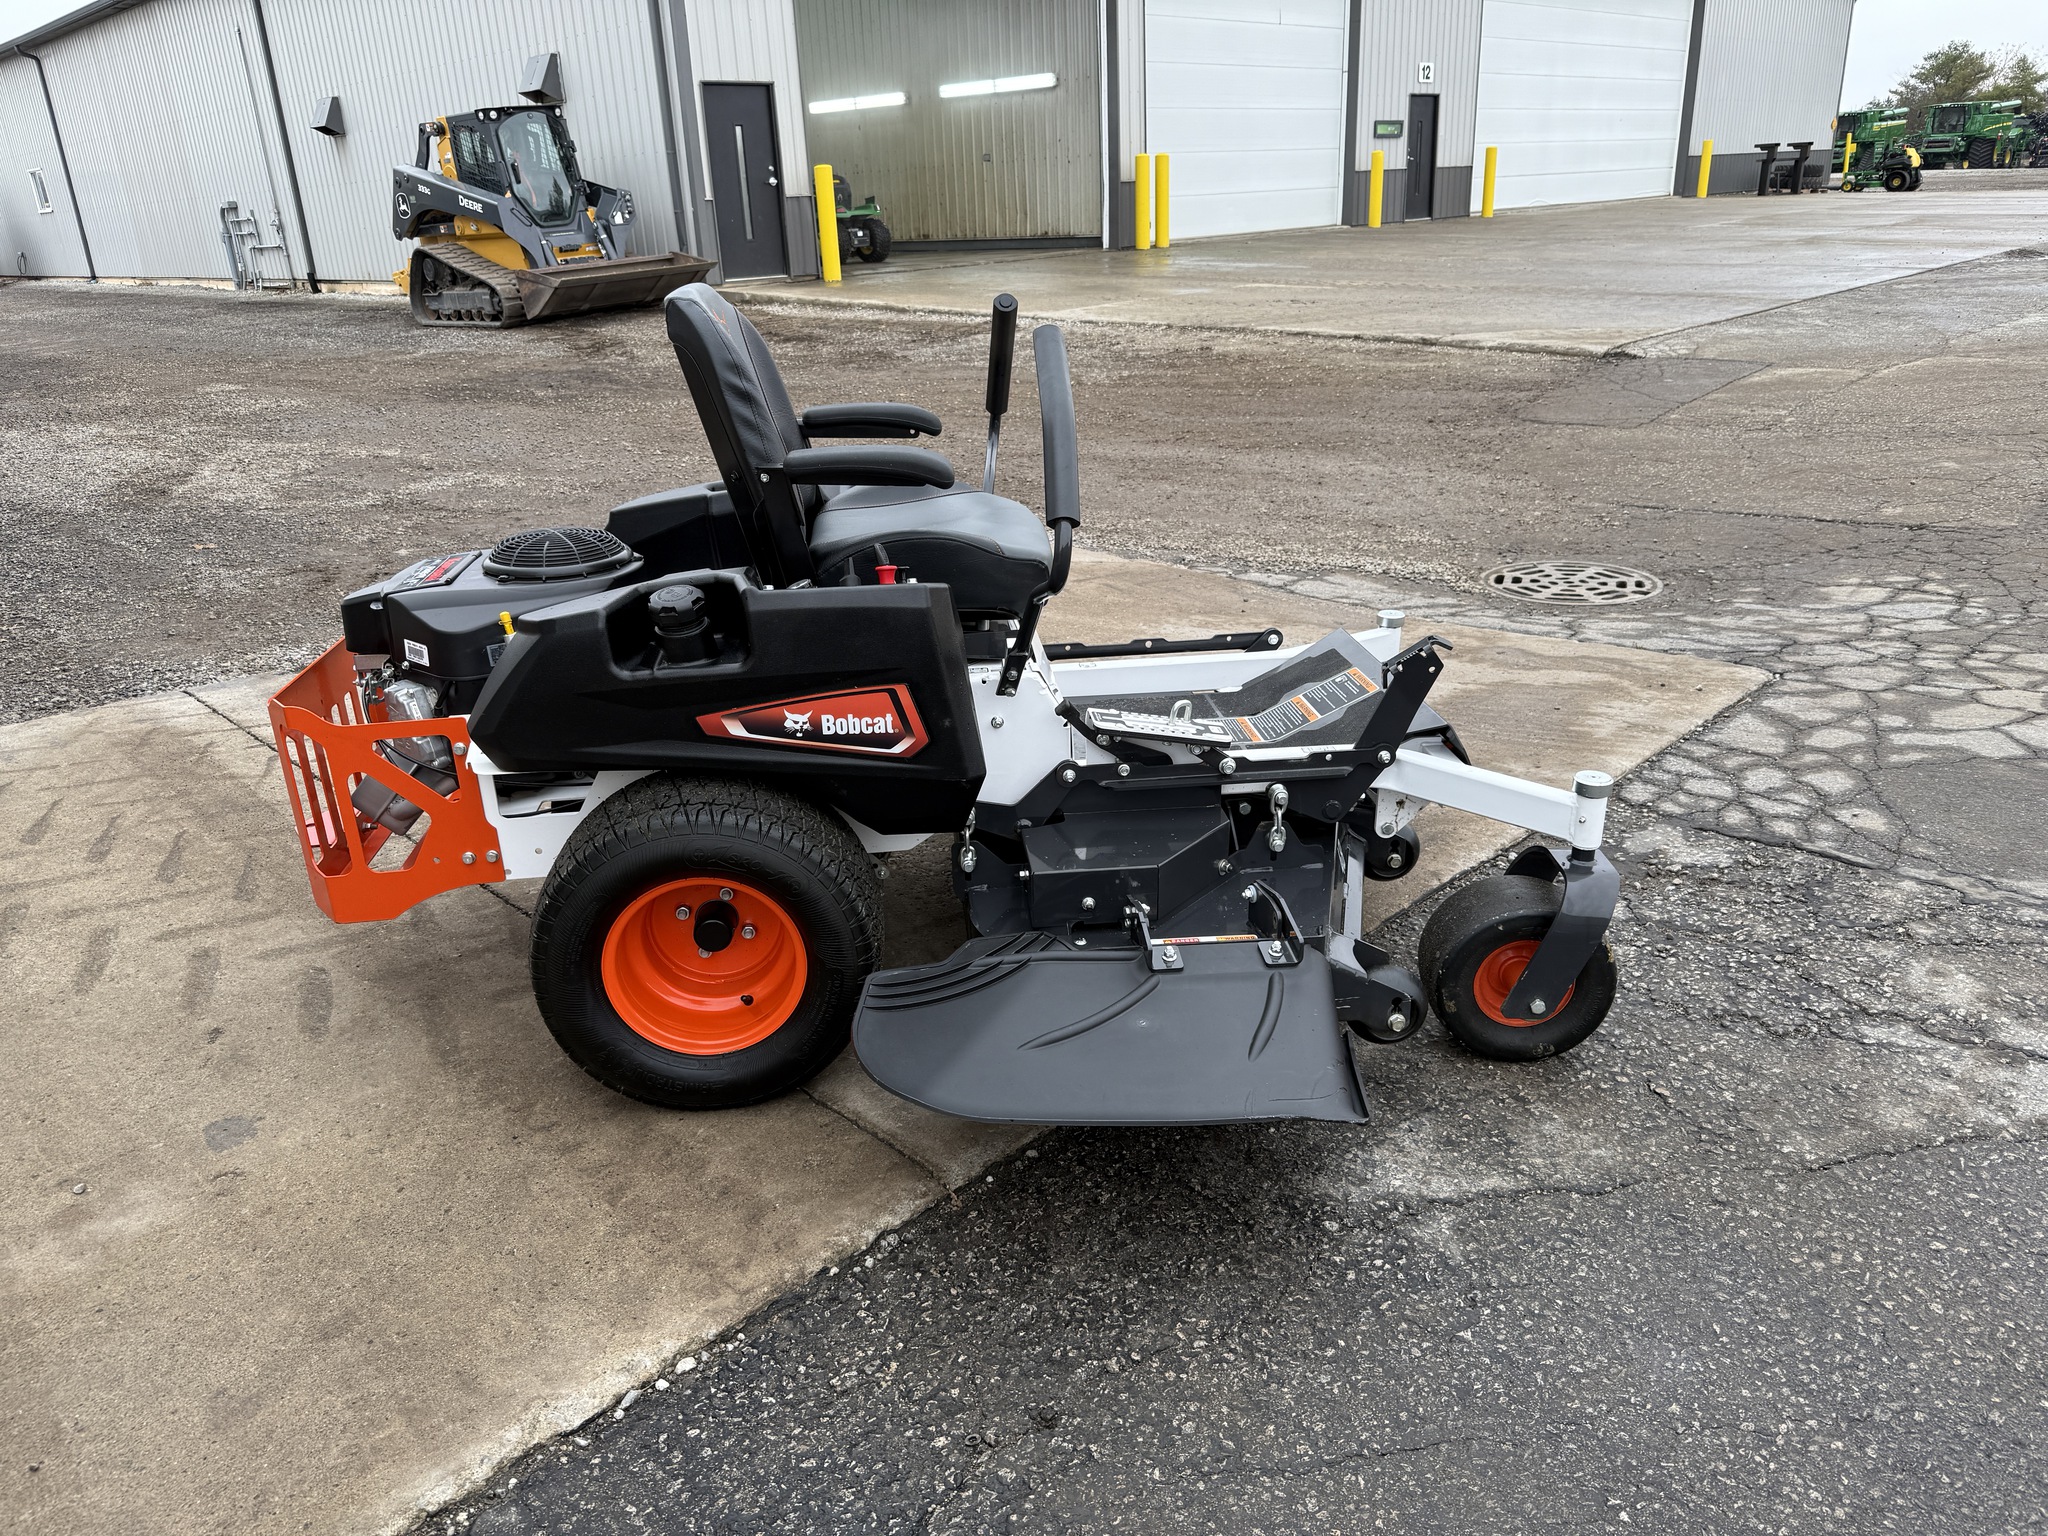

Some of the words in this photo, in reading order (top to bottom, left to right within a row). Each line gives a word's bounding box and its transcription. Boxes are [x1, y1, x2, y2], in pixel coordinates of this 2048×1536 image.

[1422, 64, 1431, 80] 12
[417, 184, 431, 195] 333G
[458, 194, 483, 213] DEERE
[821, 713, 895, 735] Bobcat
